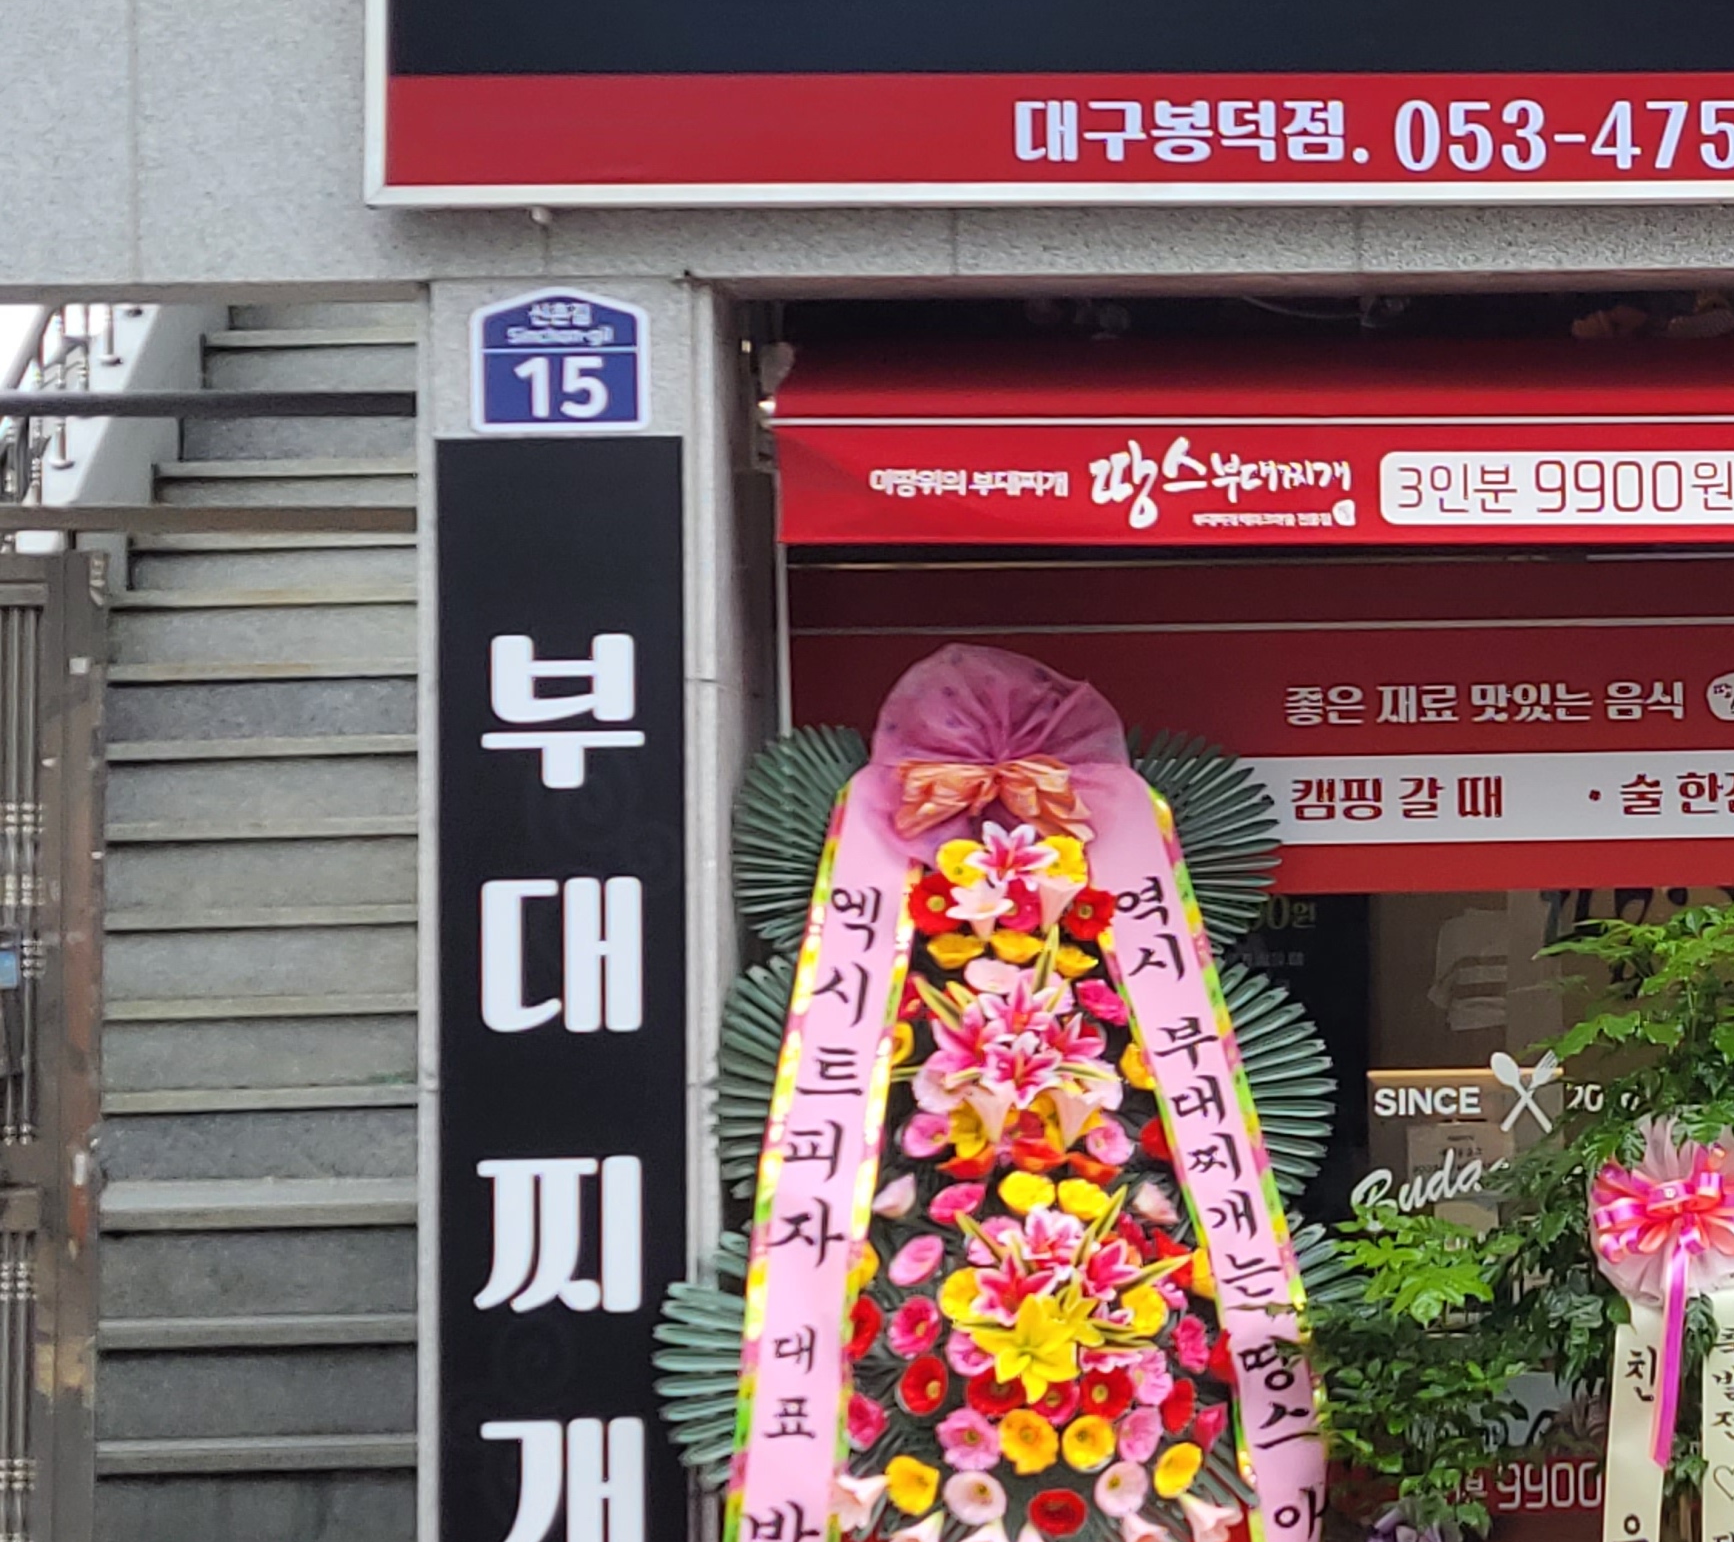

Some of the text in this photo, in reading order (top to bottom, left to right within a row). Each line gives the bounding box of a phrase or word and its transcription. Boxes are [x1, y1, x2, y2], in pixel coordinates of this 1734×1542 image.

[1013, 100, 1369, 163] 대구봉덕점.
[513, 356, 608, 419] 15
[1397, 464, 1518, 513] 3인분
[1284, 685, 1366, 726] 좋은
[1377, 685, 1458, 724] 재료
[1470, 683, 1594, 723] 맛있는
[1604, 680, 1684, 720] 음식
[1291, 777, 1383, 821] 캠핑
[1399, 776, 1445, 819] 갈
[1456, 775, 1503, 819] 때
[1619, 772, 1664, 816] 술
[1115, 876, 1186, 982] 역시
[1374, 1087, 1481, 1117] SINCE
[764, 1325, 816, 1441] 대표
